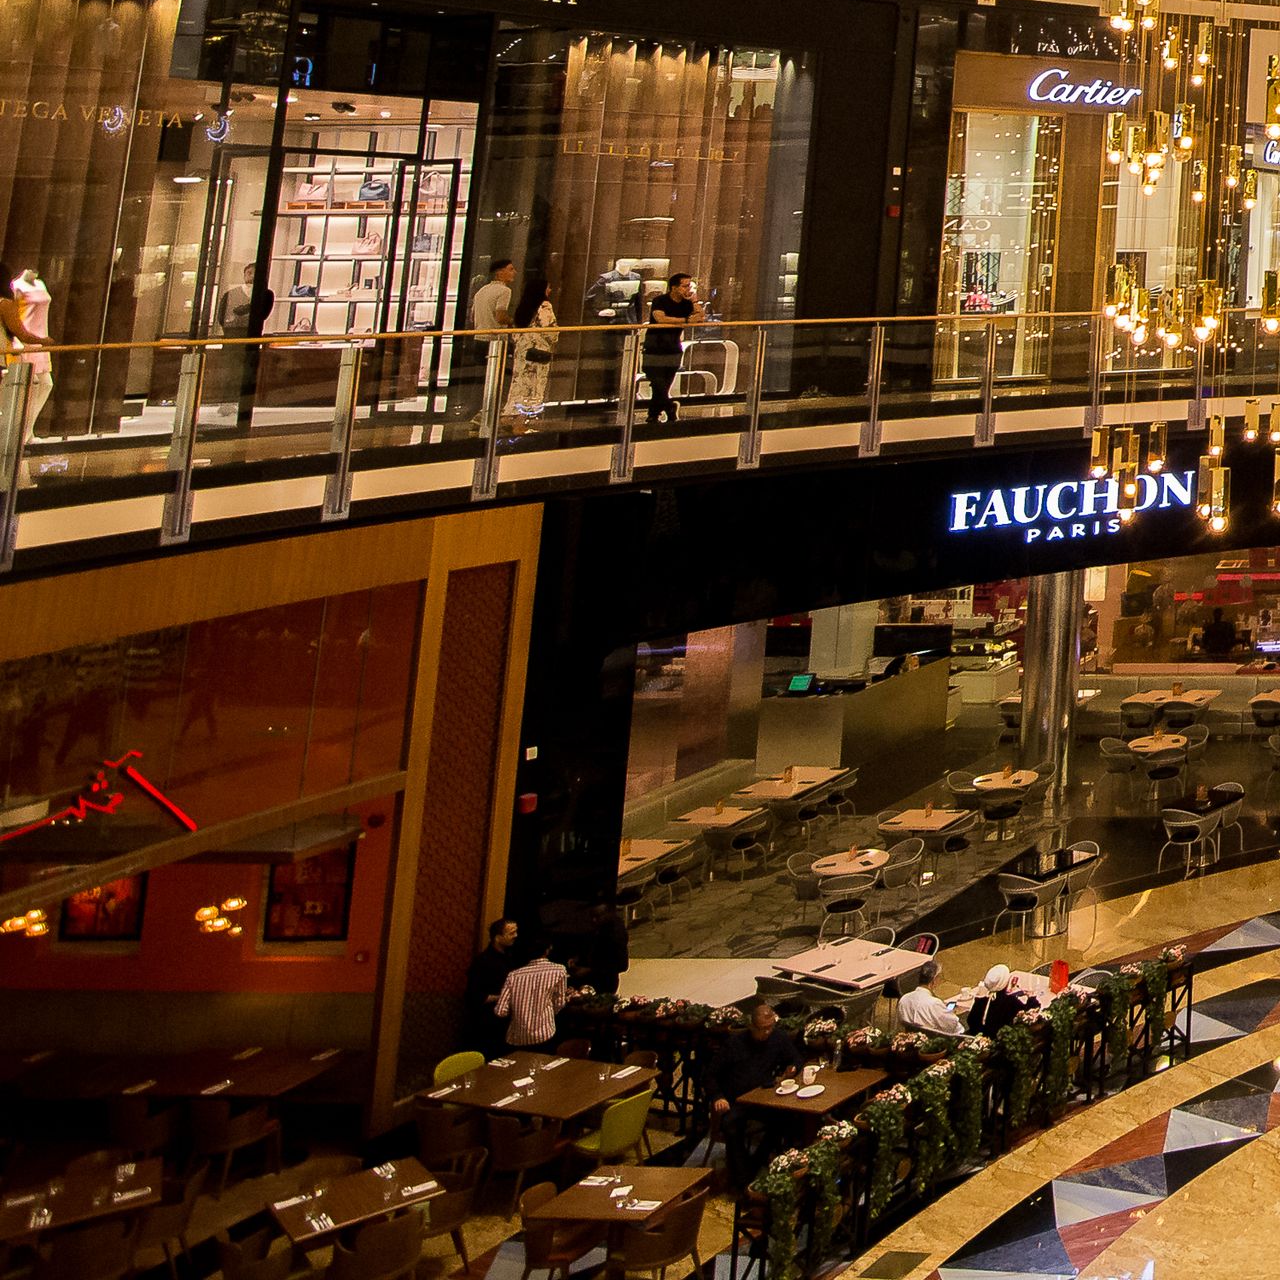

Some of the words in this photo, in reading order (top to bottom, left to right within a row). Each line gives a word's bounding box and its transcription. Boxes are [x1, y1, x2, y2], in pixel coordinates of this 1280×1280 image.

[1028, 68, 1142, 106] Cartier
[949, 470, 1196, 532] FAUCHON
[1026, 519, 1121, 544] PARIS
